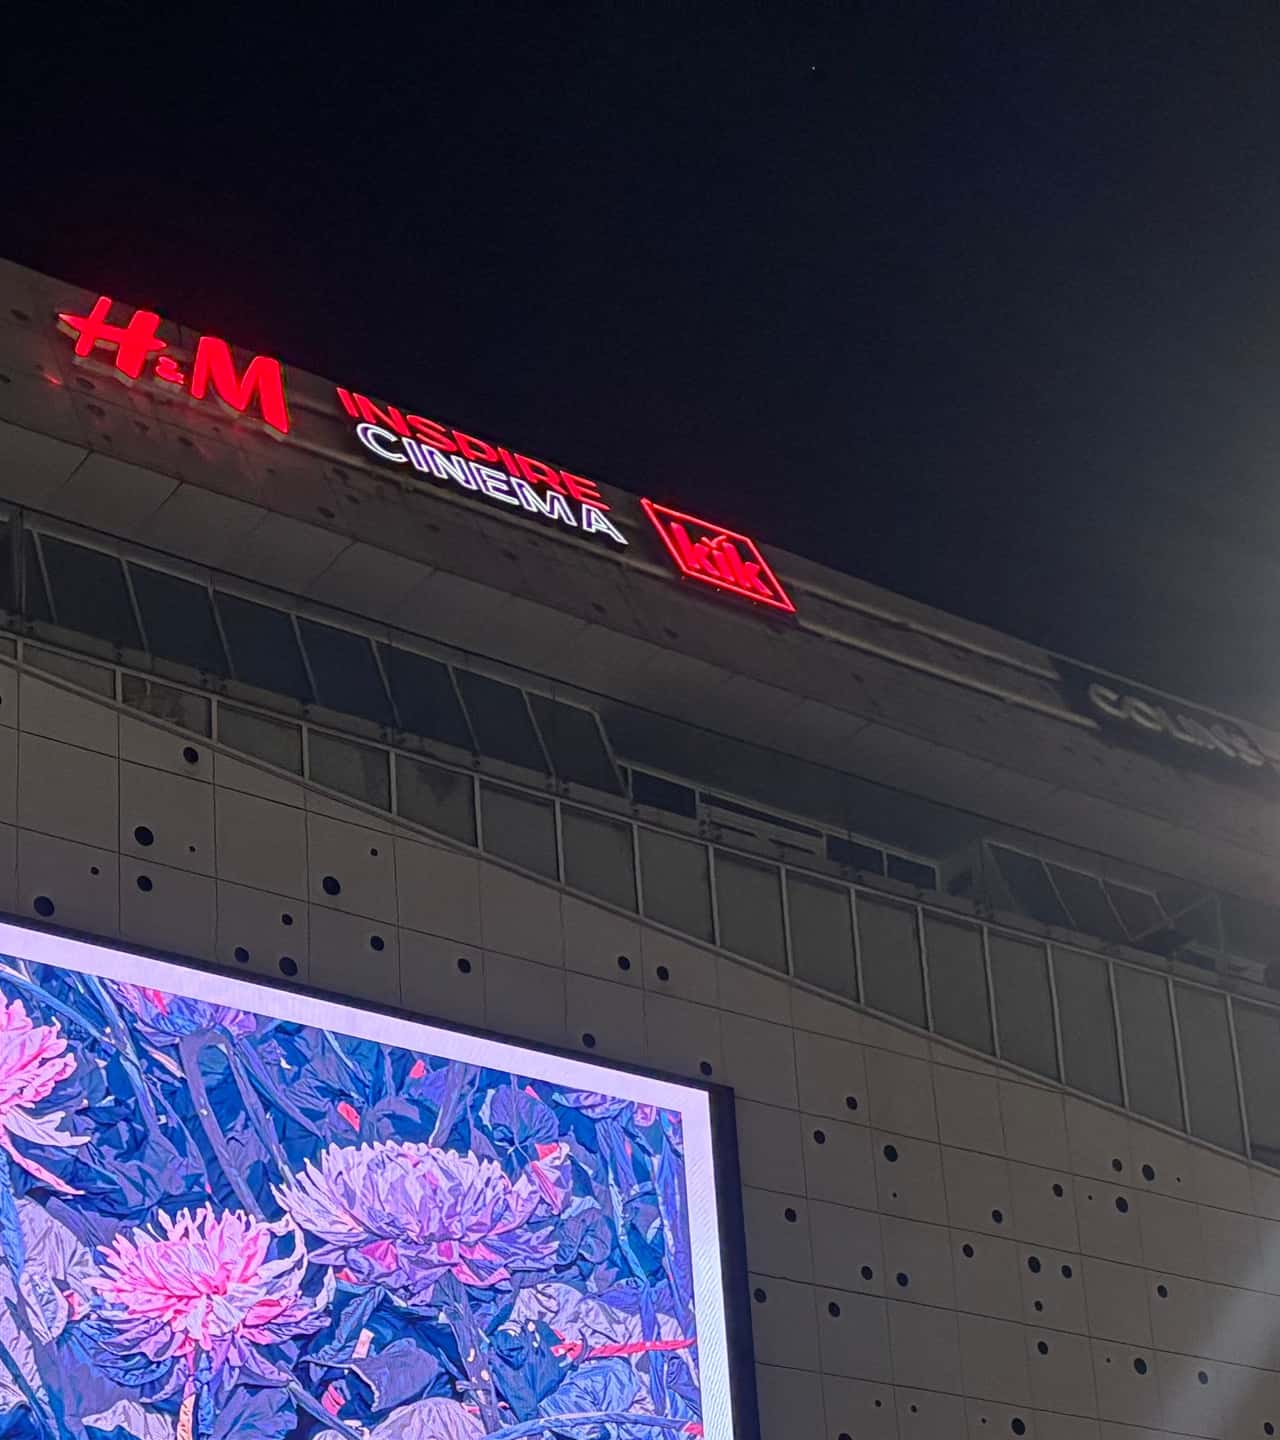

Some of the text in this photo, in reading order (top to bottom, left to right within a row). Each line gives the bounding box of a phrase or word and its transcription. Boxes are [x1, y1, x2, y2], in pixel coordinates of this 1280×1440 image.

[57, 296, 289, 434] H&M
[336, 387, 611, 511] INSPIRE
[356, 422, 629, 545] CINEMA
